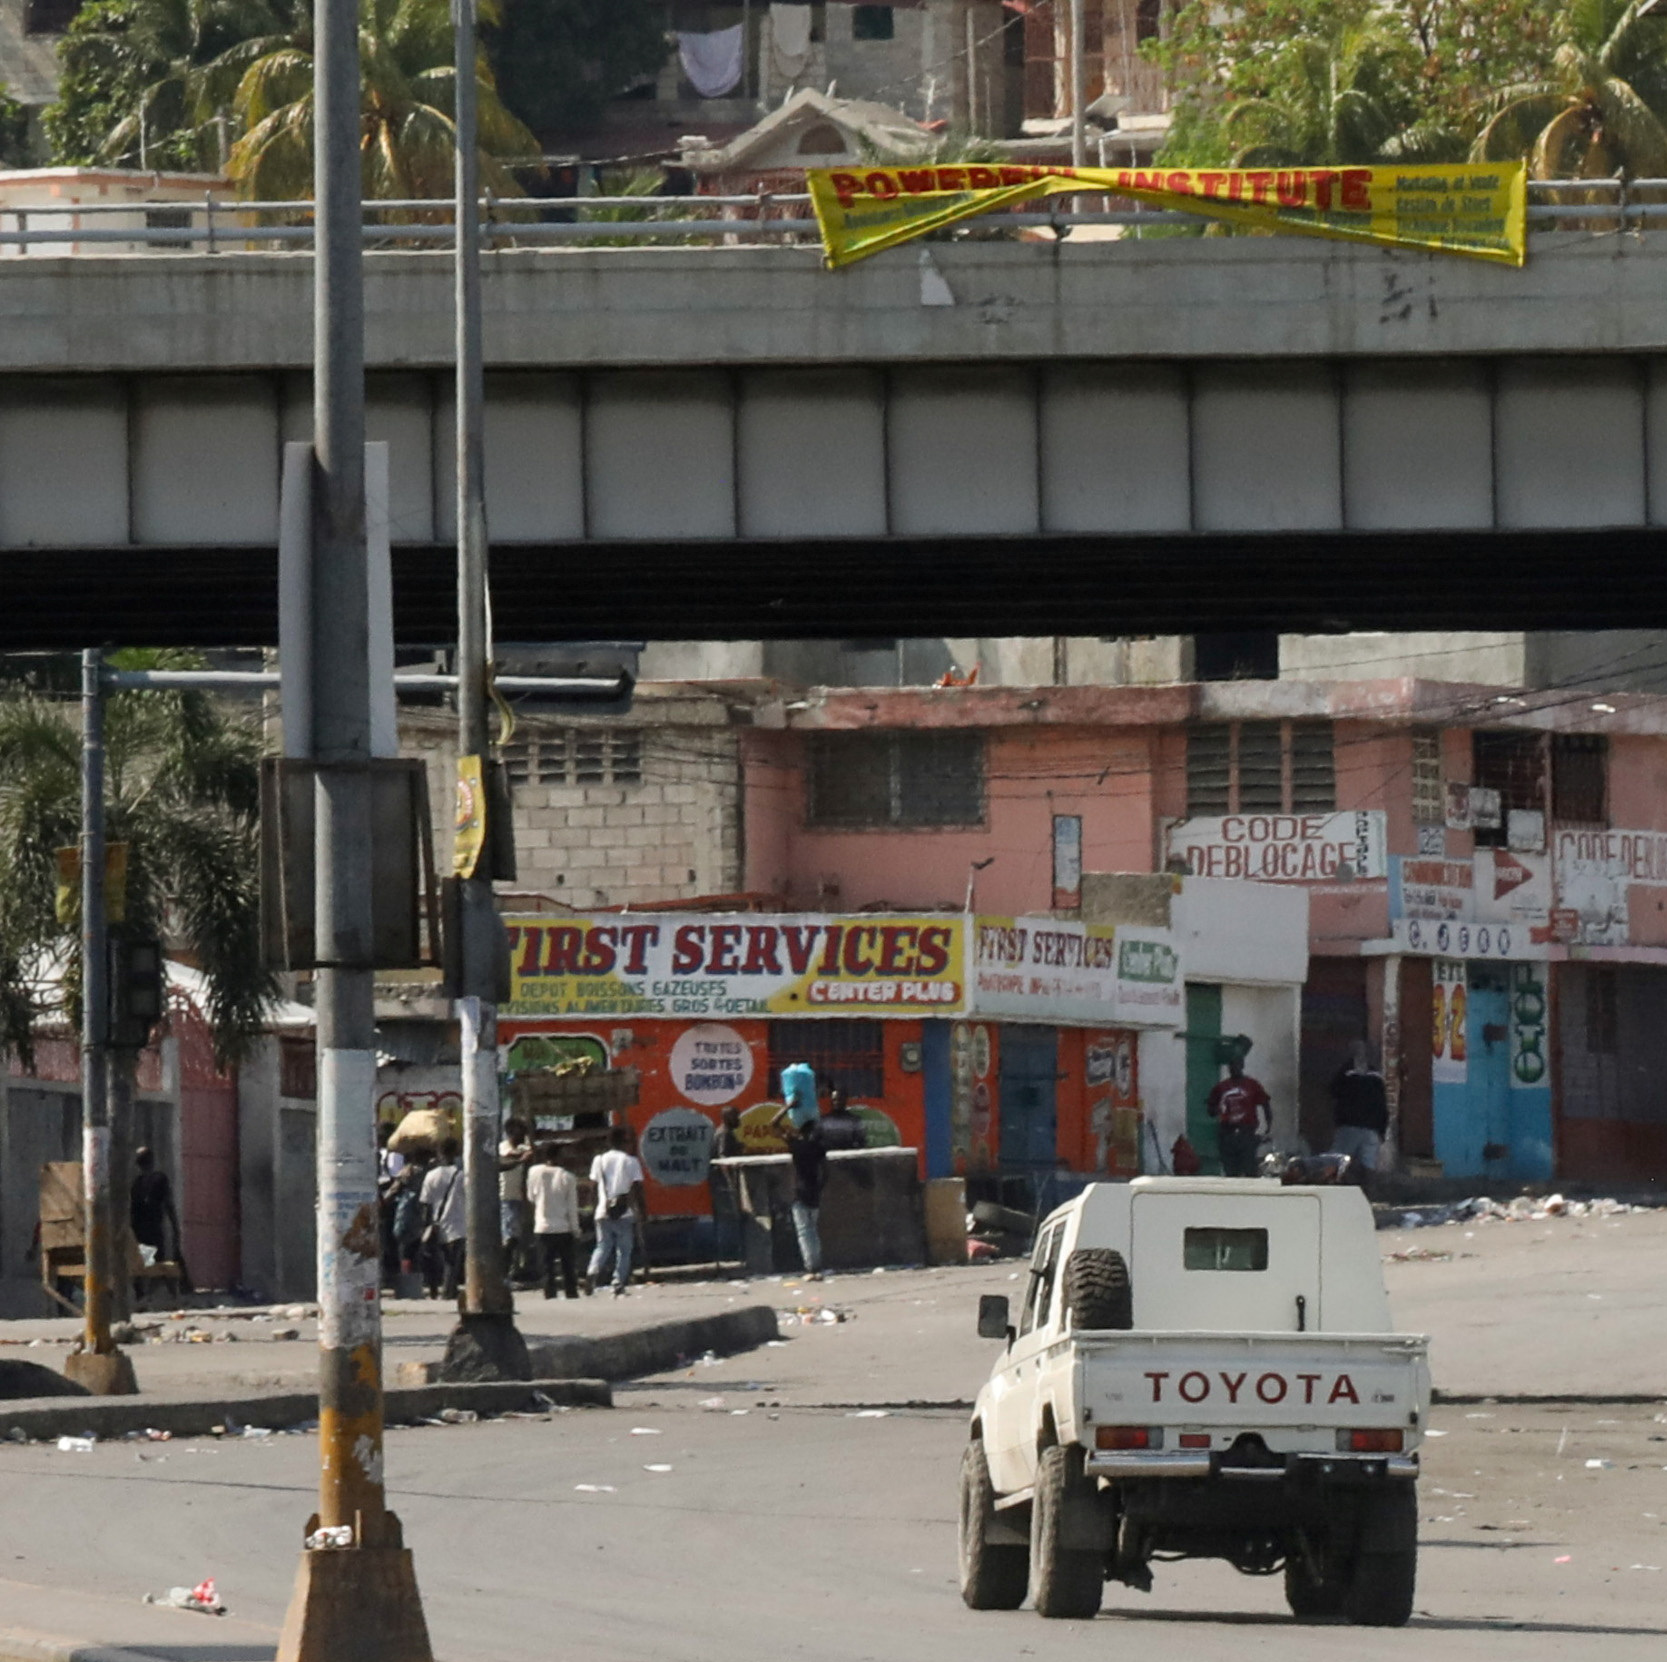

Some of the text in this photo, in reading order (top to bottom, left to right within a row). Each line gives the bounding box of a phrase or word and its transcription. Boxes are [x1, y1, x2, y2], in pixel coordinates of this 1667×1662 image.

[1117, 169, 1373, 211] INSTITUTE
[1221, 815, 1324, 843] CODE
[1186, 841, 1357, 879] DEBLOCAGE
[672, 924, 953, 977] SERVICES
[978, 925, 1114, 969] FIRST SERVICES
[809, 980, 897, 1001] CENTER
[900, 981, 957, 1002] PLUS
[649, 1126, 707, 1143] EXTRAIT
[657, 1158, 702, 1173] MALT
[1144, 1370, 1361, 1404] TOYOTA
